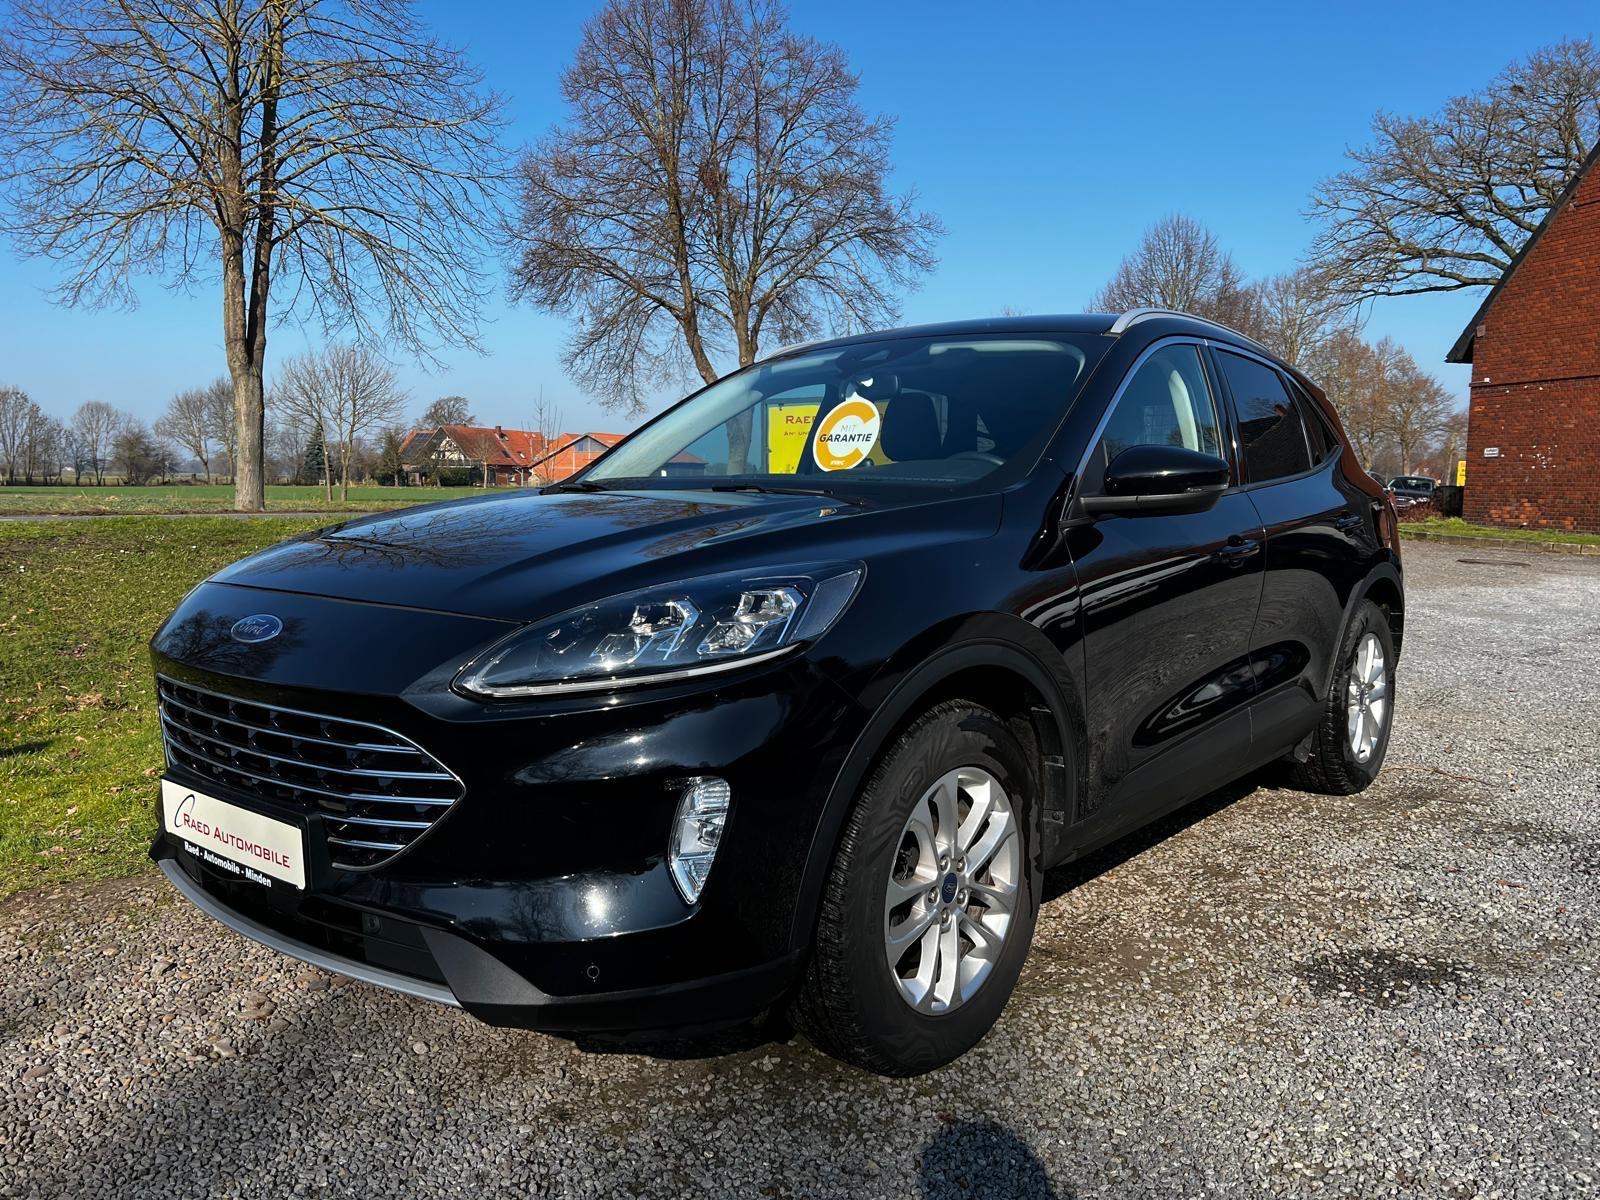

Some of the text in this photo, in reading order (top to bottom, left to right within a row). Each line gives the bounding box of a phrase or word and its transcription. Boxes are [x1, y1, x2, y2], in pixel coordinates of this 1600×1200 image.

[819, 433, 872, 442] GARANTIE
[841, 424, 856, 433] MIT
[183, 813, 291, 868] RAED AUTOMOBILE
[184, 841, 200, 857] Raed
[203, 851, 240, 874] Automobile
[245, 868, 272, 888] Minden
